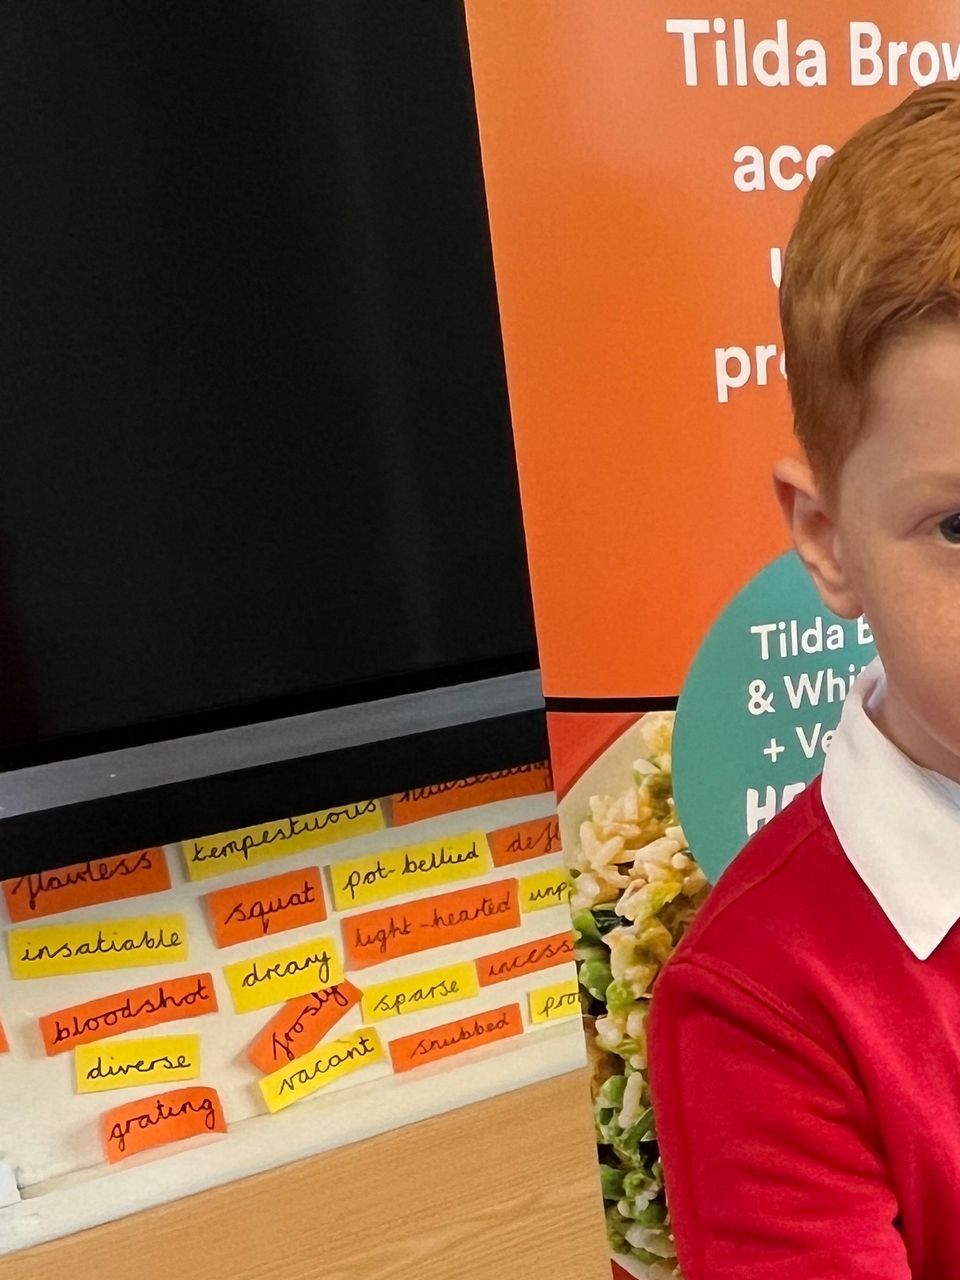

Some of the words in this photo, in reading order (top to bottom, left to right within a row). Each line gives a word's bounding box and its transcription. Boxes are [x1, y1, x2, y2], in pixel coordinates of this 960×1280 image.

[666, 17, 827, 87] Tilda
[714, 344, 787, 403] pr
[751, 616, 844, 660] Tilda
[748, 679, 776, 716] &
[784, 664, 866, 709] Whi
[763, 738, 785, 763] +
[192, 800, 377, 863] tempestuous
[223, 881, 315, 934] squat
[21, 929, 182, 961] insatiable
[242, 952, 331, 988] dreary
[53, 979, 209, 1045] bloodshot
[373, 979, 460, 1016] sparse
[411, 1013, 509, 1059] snubbed
[86, 1053, 191, 1080] diverse
[279, 1036, 375, 1095] vacant
[109, 1098, 215, 1151] grating
